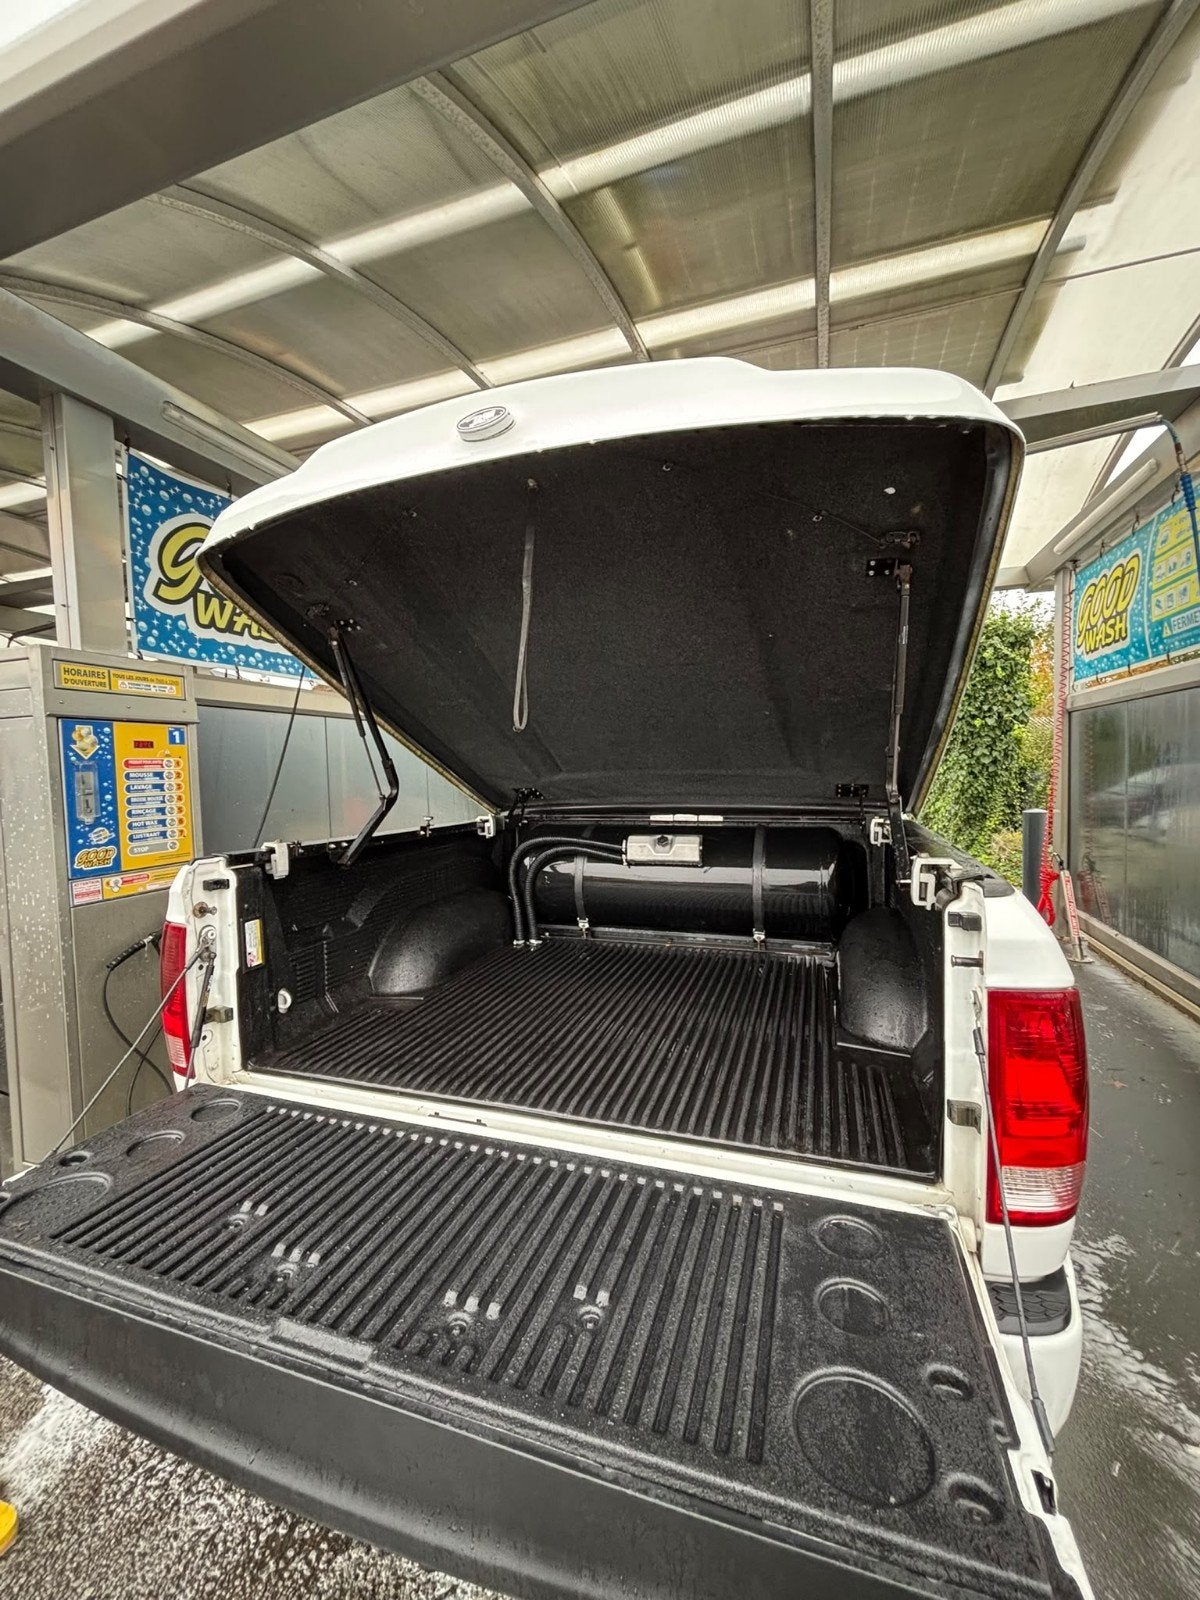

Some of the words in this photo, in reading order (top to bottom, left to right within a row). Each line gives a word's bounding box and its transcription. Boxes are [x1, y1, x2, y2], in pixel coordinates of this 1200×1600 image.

[1077, 553, 1140, 648] GOOD
[193, 589, 278, 644] WA
[1172, 609, 1200, 632] FERME
[1084, 611, 1128, 654] WASH
[63, 666, 106, 680] HORAIRES
[64, 677, 107, 688] D'OUVERTURE
[172, 731, 180, 744] 1
[132, 831, 160, 840] LUSTRANT
[76, 847, 116, 866] GOOD
[133, 846, 150, 854] STOP
[84, 859, 111, 869] WASH
